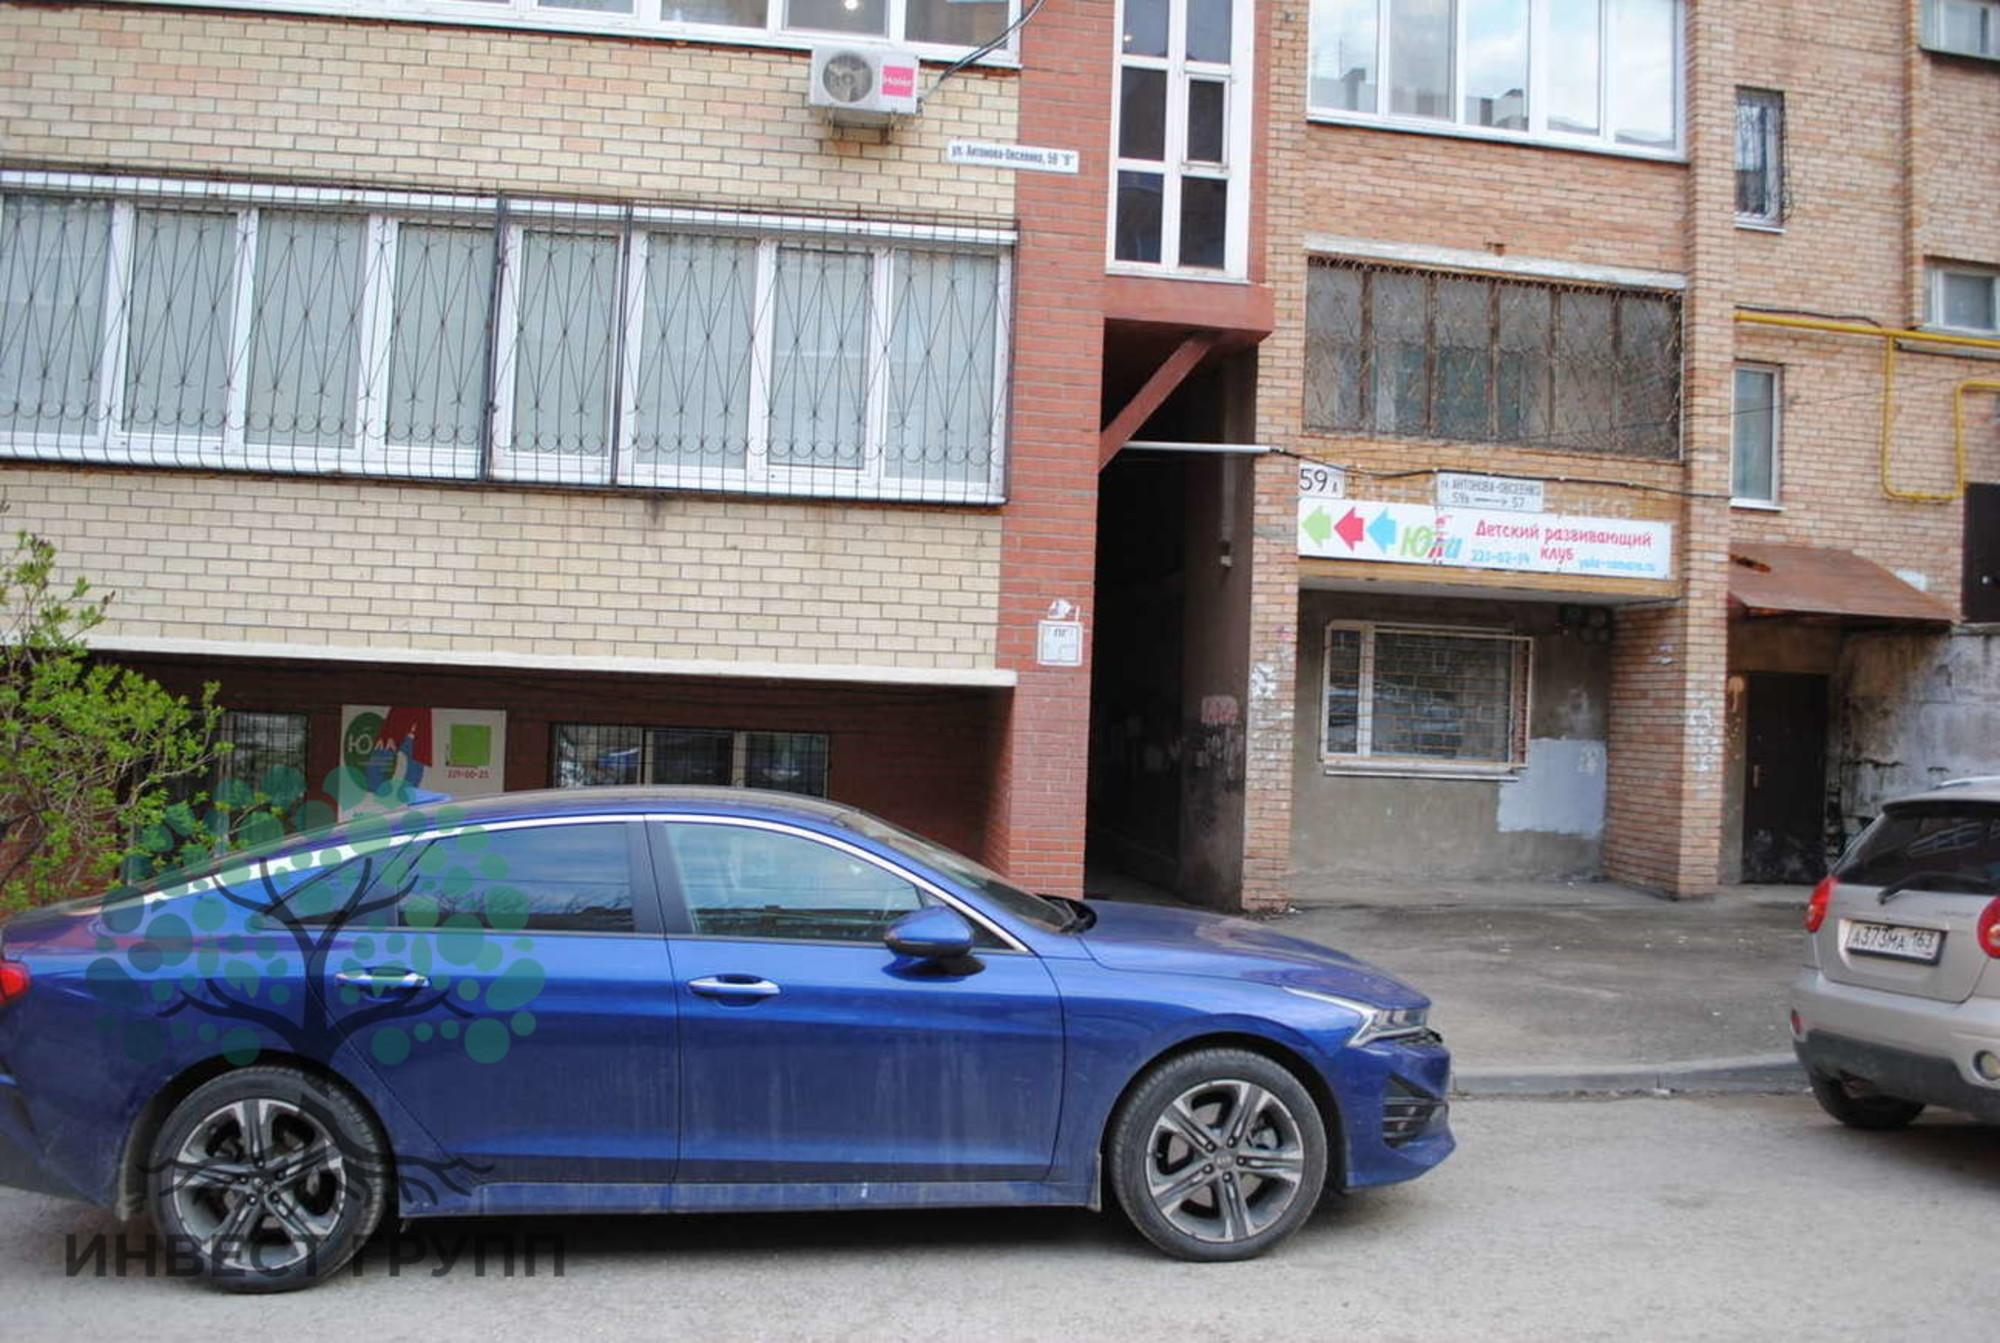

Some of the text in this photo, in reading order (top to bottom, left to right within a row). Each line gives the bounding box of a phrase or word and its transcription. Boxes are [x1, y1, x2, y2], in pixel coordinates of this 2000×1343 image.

[1475, 519, 1652, 547] Детский развивающий
[1540, 545, 1575, 564] клуб
